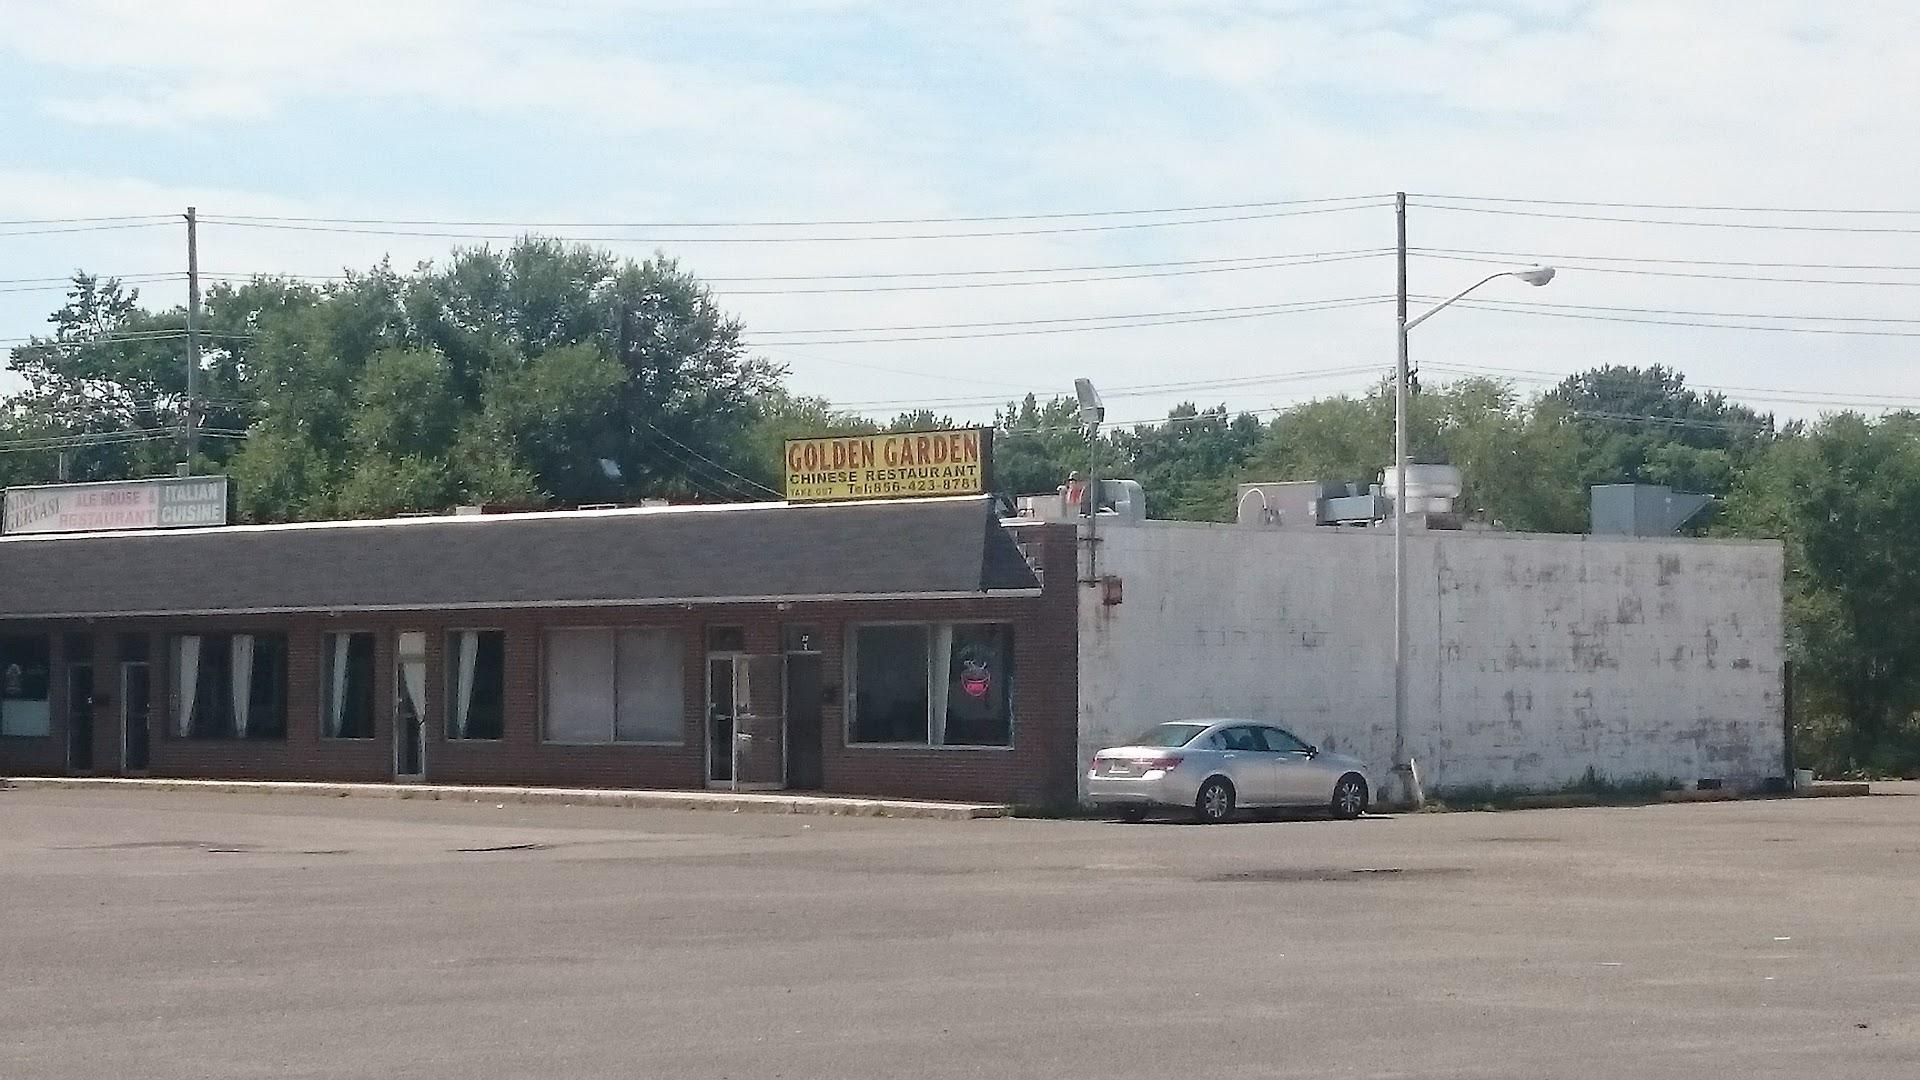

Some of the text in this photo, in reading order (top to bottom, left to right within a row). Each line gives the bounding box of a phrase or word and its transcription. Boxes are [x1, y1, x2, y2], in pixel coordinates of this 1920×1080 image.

[788, 433, 978, 472] GOLDEN GARDEN
[790, 465, 977, 485] CHINESE RESTAURANT
[101, 491, 140, 506] HOUSE
[165, 483, 218, 502] ITALIAN
[60, 510, 156, 526] RESTAURANT
[161, 503, 220, 522] CUISINE
